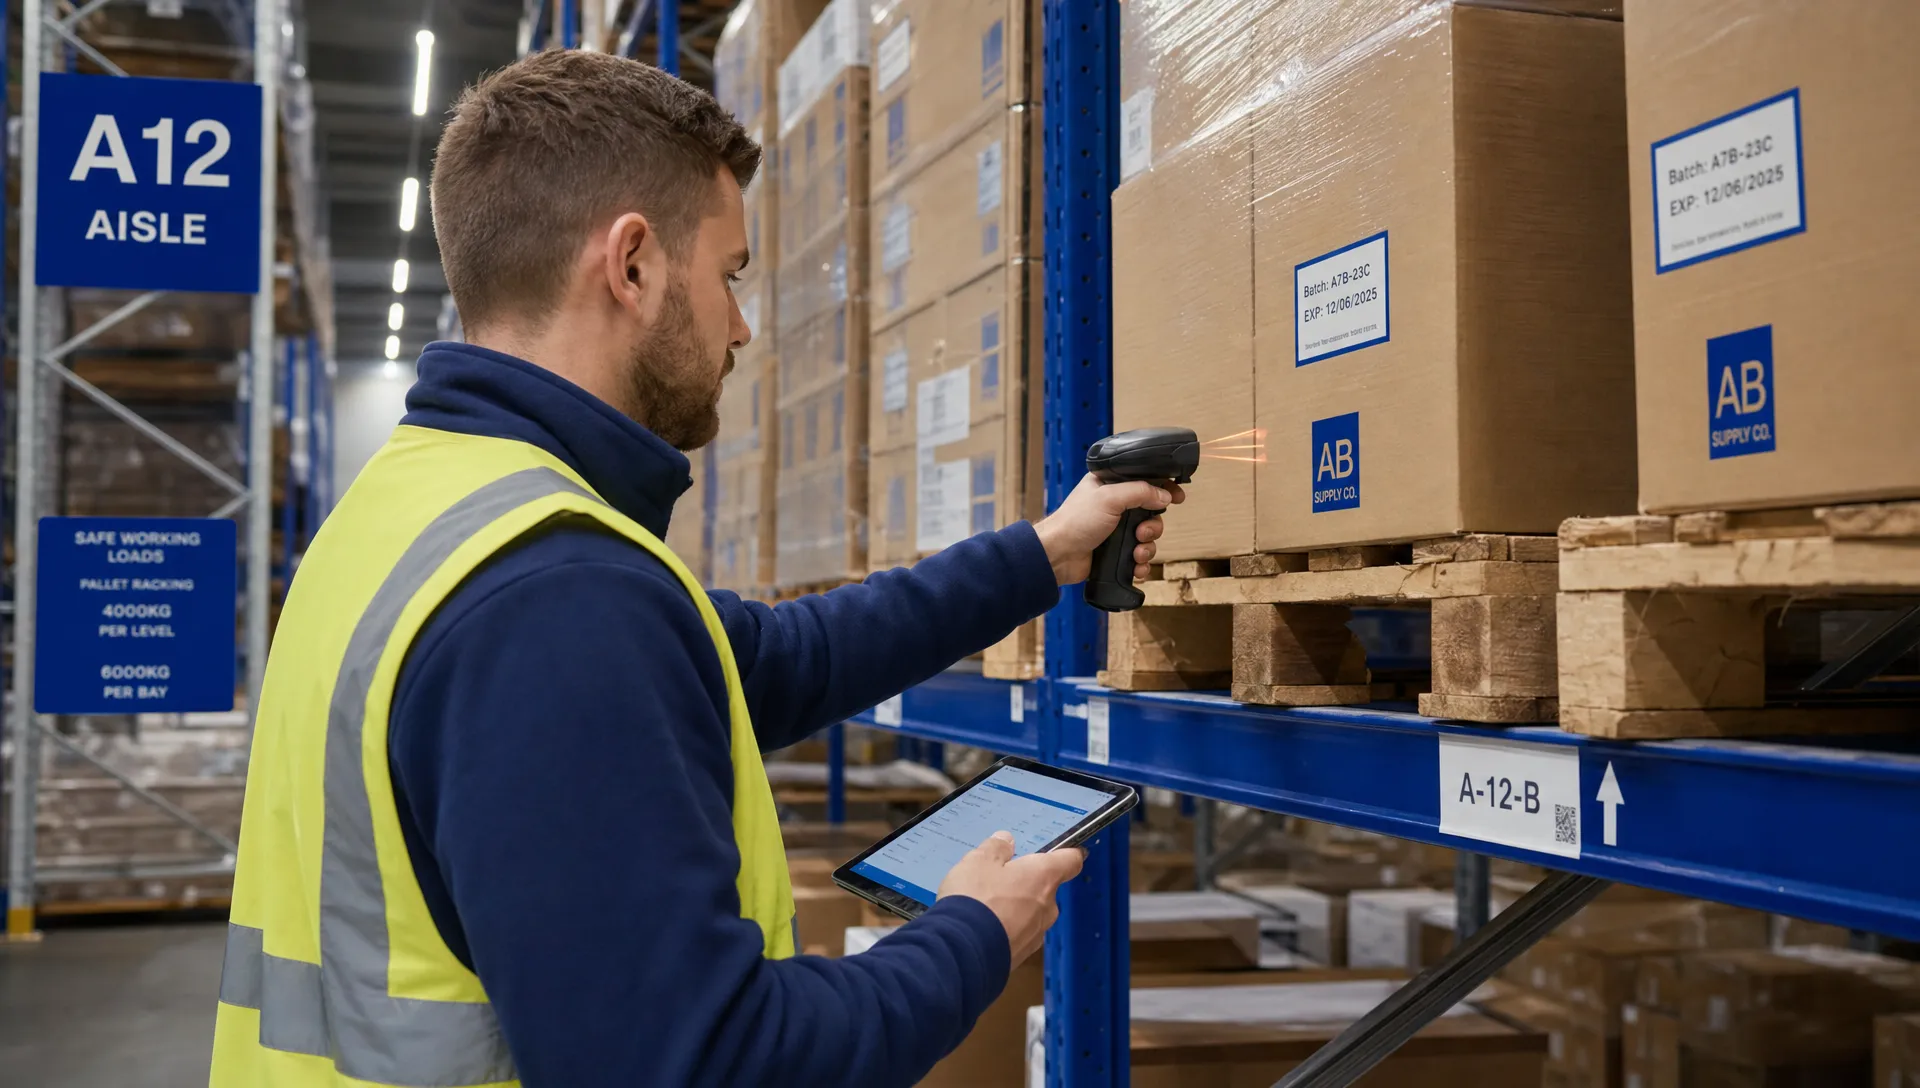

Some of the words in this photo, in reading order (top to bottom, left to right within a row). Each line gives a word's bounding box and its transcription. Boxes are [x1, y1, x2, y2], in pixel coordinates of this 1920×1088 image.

[69, 114, 231, 188] A12
[1668, 161, 1708, 186] Batch:
[1711, 135, 1774, 171] A7B-23C
[1669, 195, 1700, 217] EXP:
[1704, 164, 1785, 205] 12/06/2025
[85, 209, 206, 245] AISLE
[1303, 280, 1329, 298] Batch:
[1331, 263, 1371, 289] A7B-23C
[1304, 306, 1323, 323] EXP:
[1325, 287, 1378, 315] 12/06/2025
[1715, 360, 1767, 419] AB
[1711, 426, 1751, 448] SUPPLY
[1752, 423, 1772, 442] CO.
[1317, 438, 1354, 482] AB
[1314, 488, 1342, 504] SUPPLY
[1343, 486, 1358, 500] CO.
[74, 531, 116, 545] SAFE
[120, 531, 201, 546] WORKING
[107, 549, 165, 563] LOADS
[79, 578, 129, 590] PALLET
[131, 578, 195, 591] RACKING
[102, 604, 172, 618] 4000KG
[99, 624, 127, 637] PER
[131, 624, 175, 637] LEVEL
[100, 665, 171, 679] 6000KG
[103, 685, 133, 699] PER
[137, 685, 169, 699] BAY
[1459, 772, 1541, 814] A-12-B
